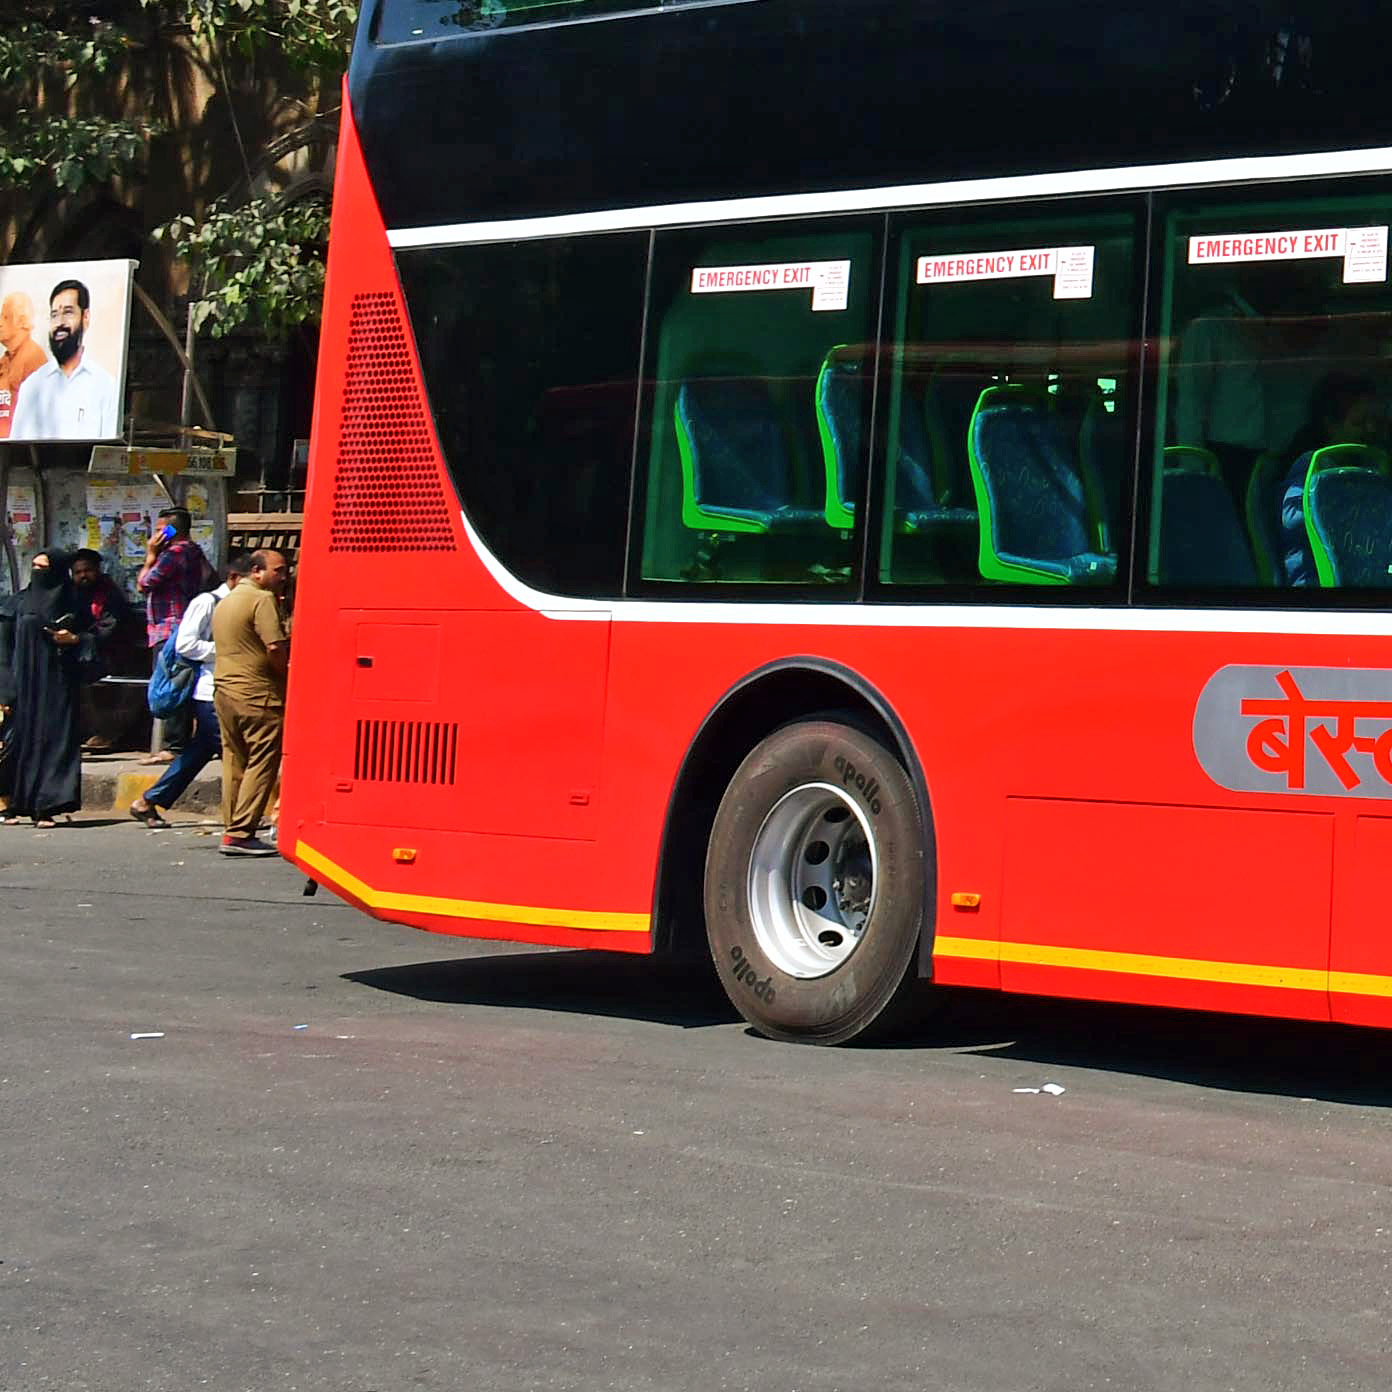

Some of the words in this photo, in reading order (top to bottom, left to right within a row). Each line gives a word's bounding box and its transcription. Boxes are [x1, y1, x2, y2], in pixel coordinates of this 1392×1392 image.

[1196, 236, 1298, 258] EMERGENCY
[1303, 233, 1339, 253] EXIT
[698, 268, 779, 288] EMERGENCY
[783, 266, 812, 284] EXIT
[924, 256, 1015, 278] EMERGENCY
[1019, 253, 1051, 271] EXIT
[834, 755, 881, 815] apollo
[730, 946, 776, 1005] apollo
